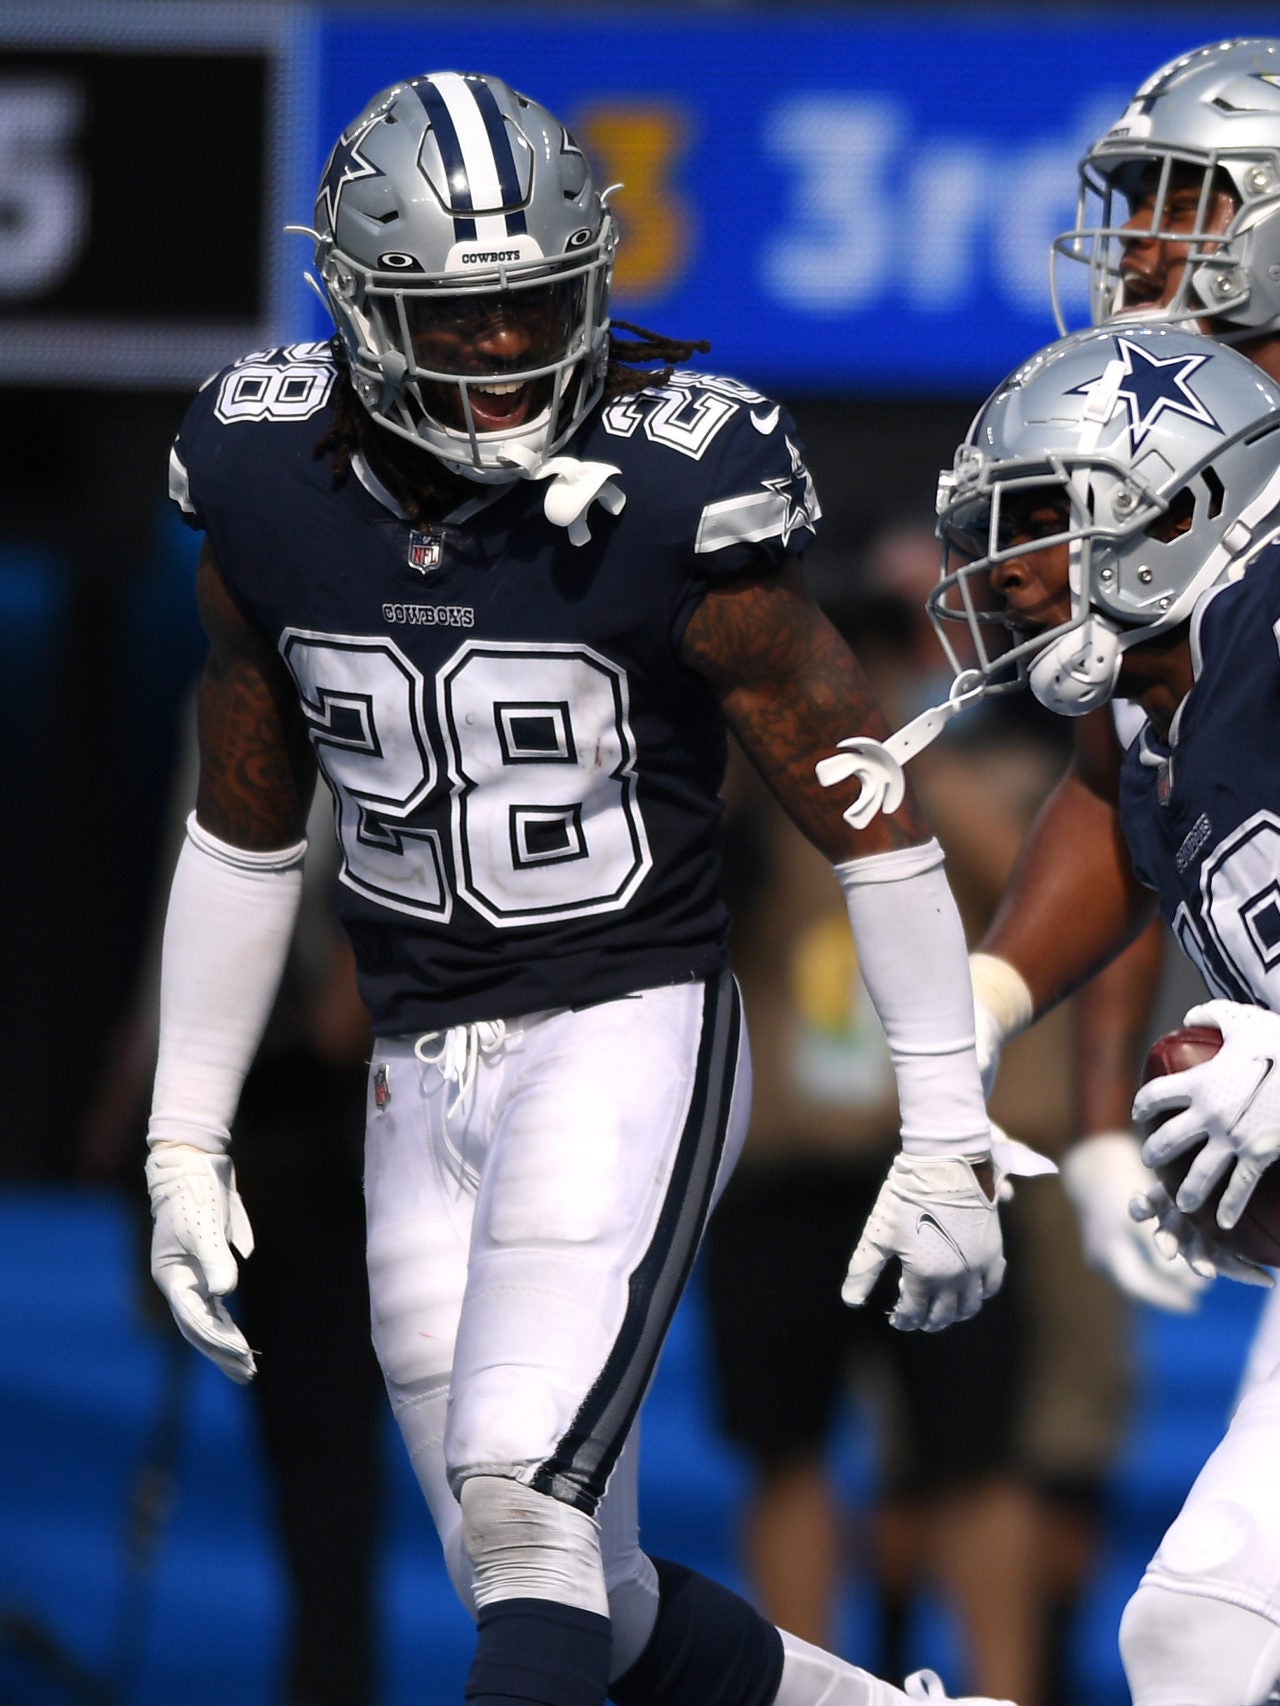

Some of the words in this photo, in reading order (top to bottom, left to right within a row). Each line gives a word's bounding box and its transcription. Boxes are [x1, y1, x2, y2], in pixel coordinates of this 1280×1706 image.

[461, 249, 521, 264] COWBOYS
[382, 603, 475, 628] COWBOYS
[278, 626, 653, 928] 28
